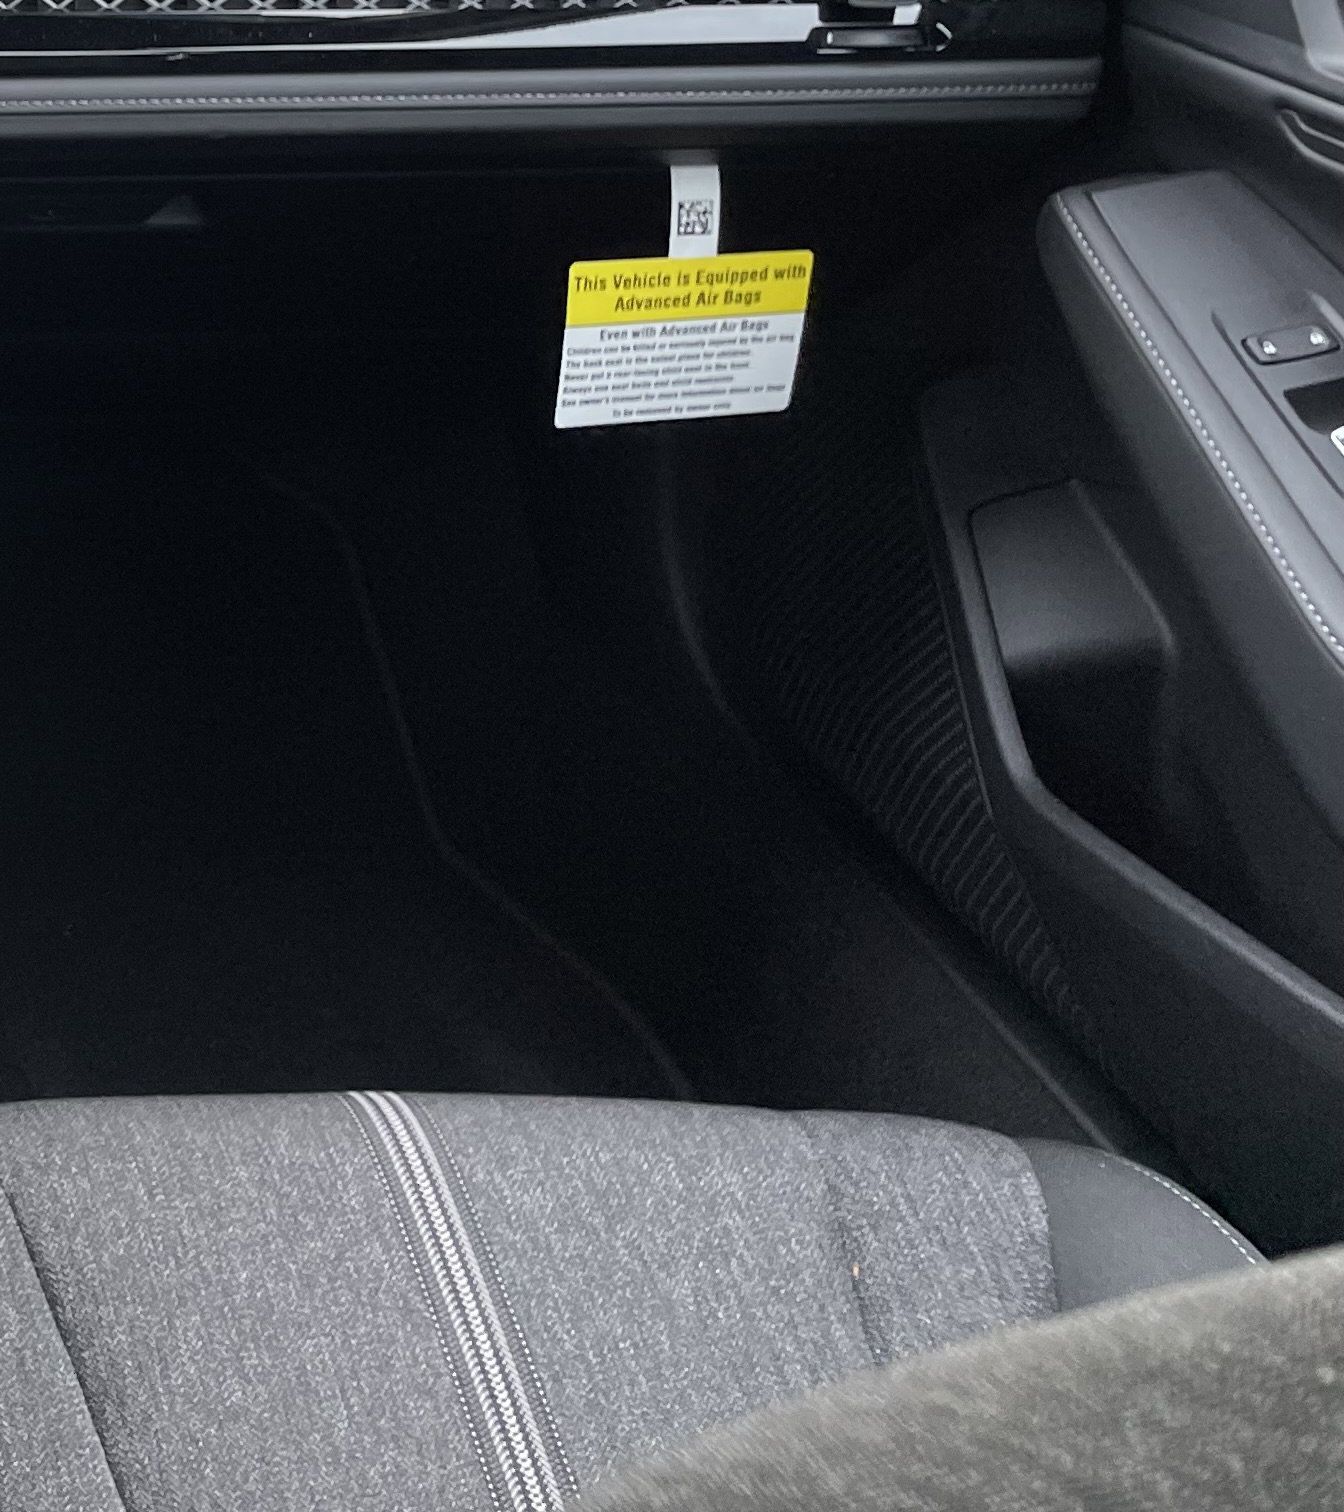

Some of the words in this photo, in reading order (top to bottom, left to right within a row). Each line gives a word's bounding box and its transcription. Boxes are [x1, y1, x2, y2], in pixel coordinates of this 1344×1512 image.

[575, 274, 606, 292] This
[614, 272, 671, 291] Vehicle
[678, 270, 691, 287] is
[696, 265, 768, 287] Equipped
[774, 263, 807, 280] with
[615, 294, 690, 312] Advanced
[696, 290, 718, 307] Air
[723, 289, 761, 307] Bags
[600, 329, 628, 341] Even
[632, 327, 657, 338] with
[660, 323, 716, 337] Advanced
[720, 321, 737, 333] Air
[741, 319, 769, 332] Bags
[567, 347, 601, 356] Children
[567, 360, 580, 368] The
